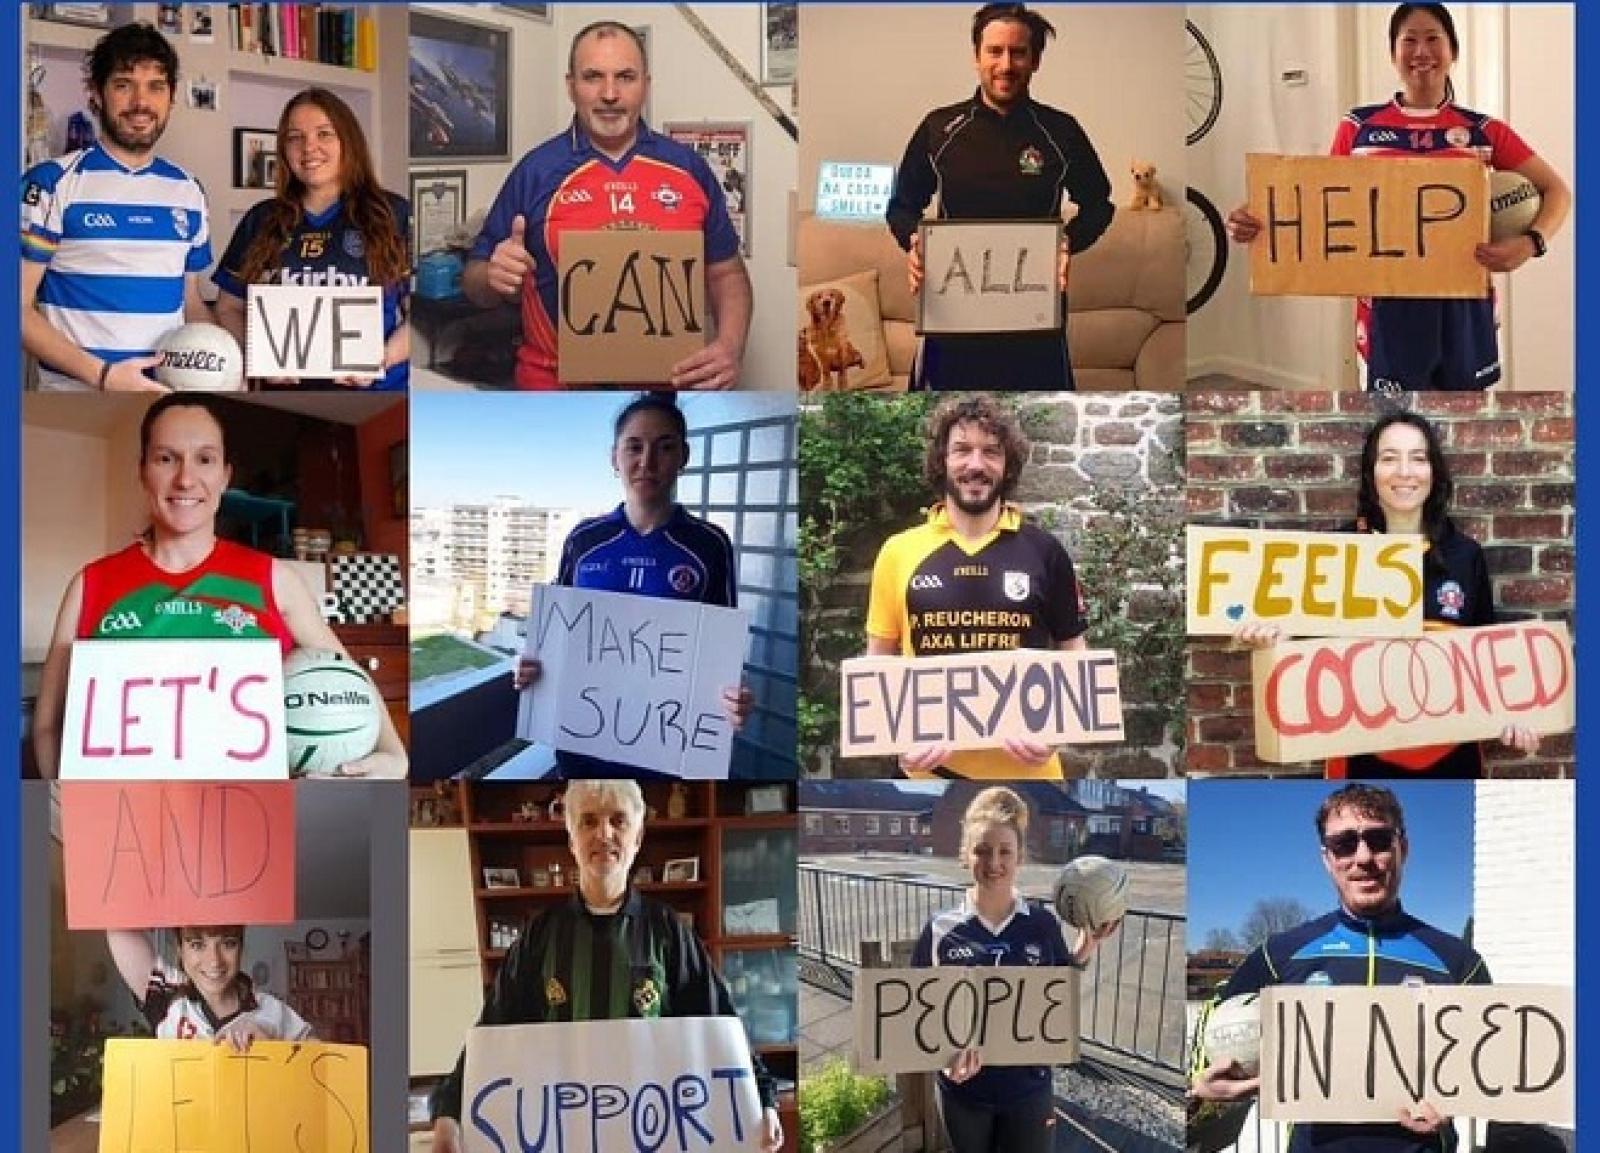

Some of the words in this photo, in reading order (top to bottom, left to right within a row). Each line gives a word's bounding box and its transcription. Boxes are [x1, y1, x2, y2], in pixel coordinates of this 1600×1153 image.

[609, 192, 634, 214] 14
[1267, 184, 1465, 263] HELP
[563, 250, 702, 337] CAN
[939, 247, 1048, 294] ALL
[256, 296, 378, 372] WE
[1197, 541, 1422, 619] FEELS
[538, 602, 687, 678] MAKE
[921, 633, 955, 649] AXA
[82, 667, 271, 761] LET'S
[560, 687, 726, 751] SURE
[847, 658, 1121, 744] EVERYONE
[1265, 628, 1568, 736] COCOONED
[104, 786, 270, 901] AND
[875, 977, 1068, 1061] PEOPLE
[1277, 1001, 1334, 1102] IN
[1367, 1002, 1567, 1102] NEED
[470, 1068, 749, 1153] SUPPORT
